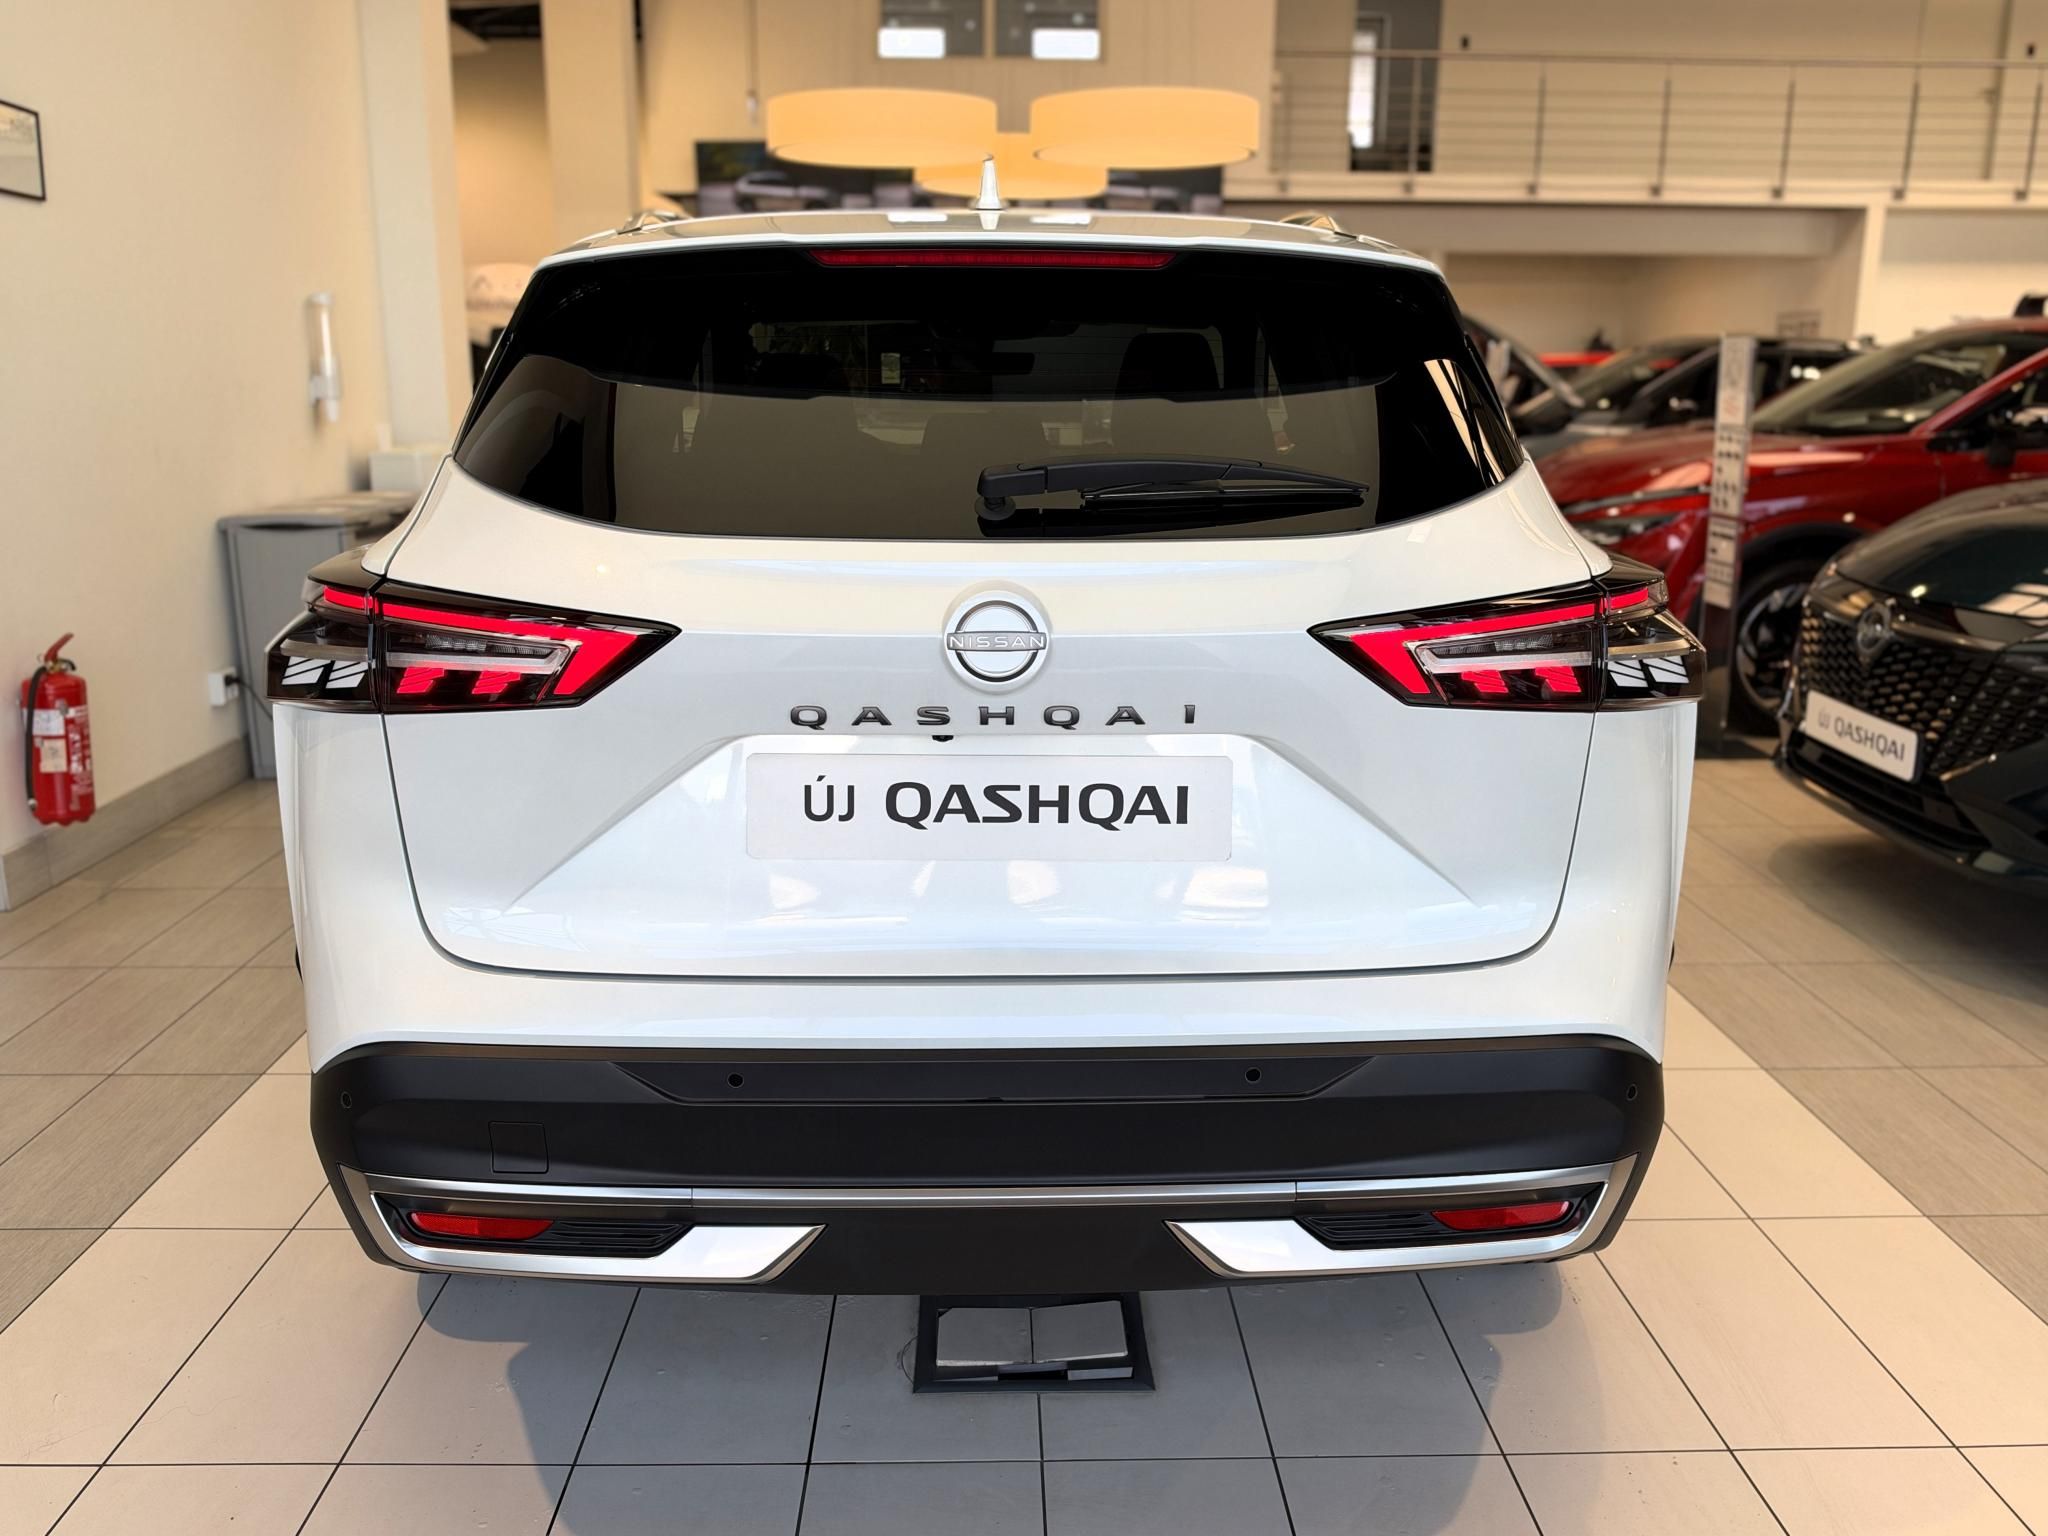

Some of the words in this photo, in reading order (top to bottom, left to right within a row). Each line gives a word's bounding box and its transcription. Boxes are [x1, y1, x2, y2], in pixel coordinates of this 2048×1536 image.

[949, 635, 1045, 648] NISSAN
[789, 703, 1197, 730] QASHQAI
[1834, 716, 1905, 761] QASHQAI
[803, 774, 856, 822] ÚJ
[885, 781, 1190, 831] QASHQAI
